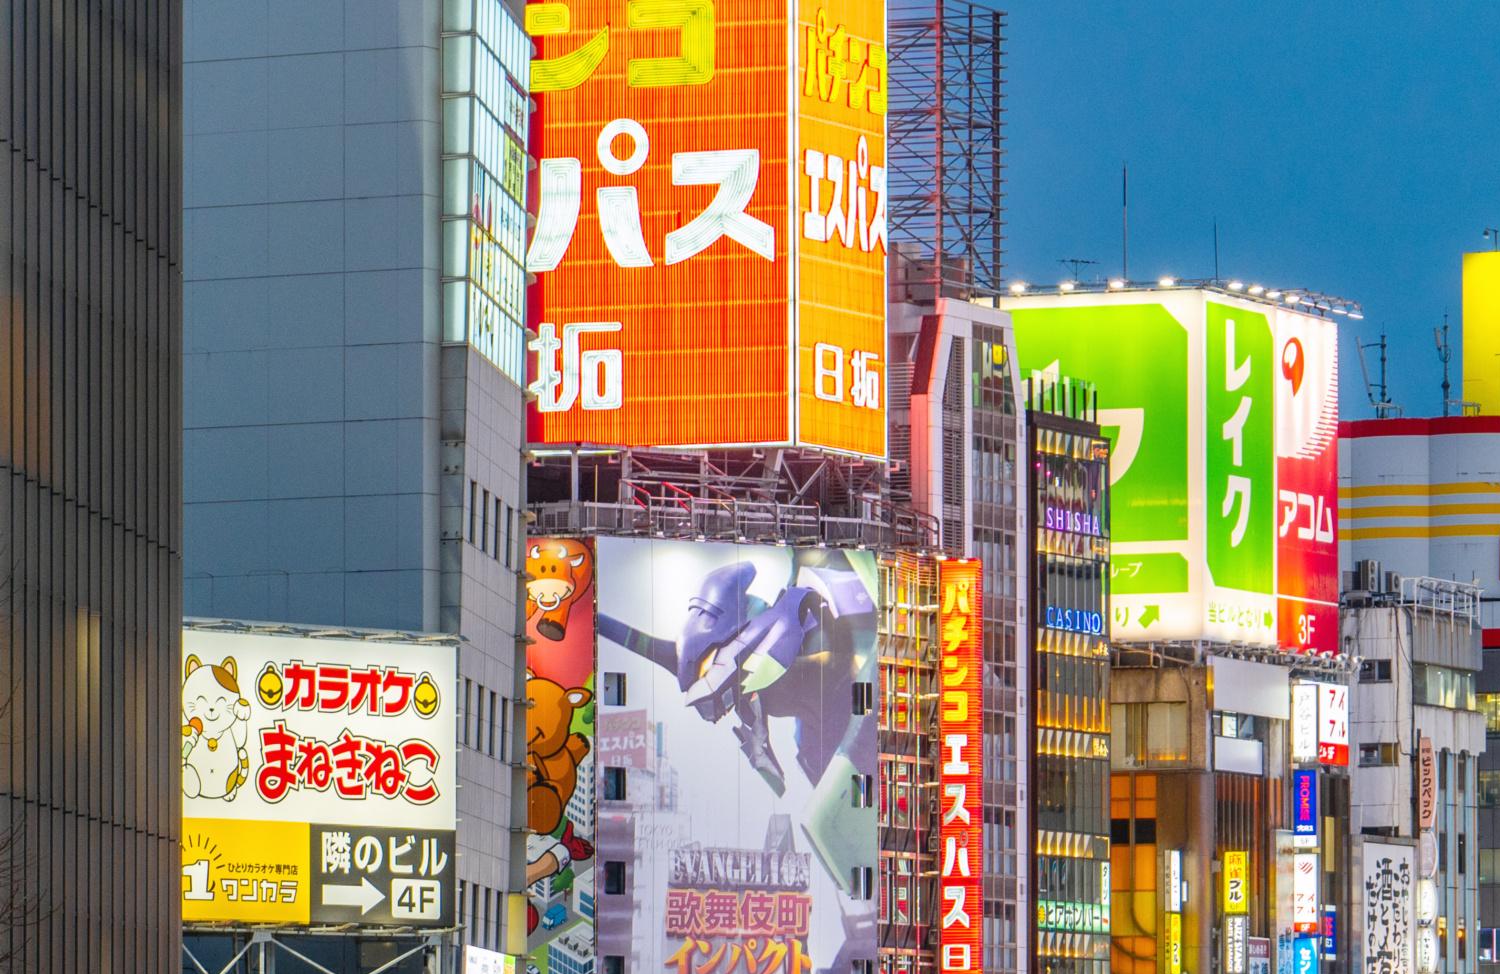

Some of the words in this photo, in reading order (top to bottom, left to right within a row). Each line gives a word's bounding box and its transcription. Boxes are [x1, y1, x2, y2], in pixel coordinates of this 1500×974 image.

[804, 9, 888, 116] パチンコ
[526, 118, 775, 273] パス
[804, 135, 889, 254] エスパス
[529, 322, 623, 413] 拓
[814, 342, 880, 410] 日拓
[1222, 318, 1253, 549] レイク
[1046, 507, 1100, 536] SHISHA
[1279, 490, 1335, 544] アコム
[1046, 606, 1101, 635] CASINO
[1298, 614, 1316, 644] 3F
[942, 580, 971, 722] パチンコ
[283, 661, 414, 717] カラオケ
[258, 722, 441, 803] まねきねこ
[600, 731, 646, 752] エスパス
[1299, 775, 1310, 821] PROMISE
[321, 831, 449, 876] 隣のビル
[942, 733, 971, 930] エスパス
[220, 878, 298, 903] ワンカラ
[227, 862, 299, 876] ひとりカラオケ専門店
[671, 850, 812, 887] EVANGELION
[396, 884, 436, 914] 4F
[667, 891, 813, 936] 歌舞伎町
